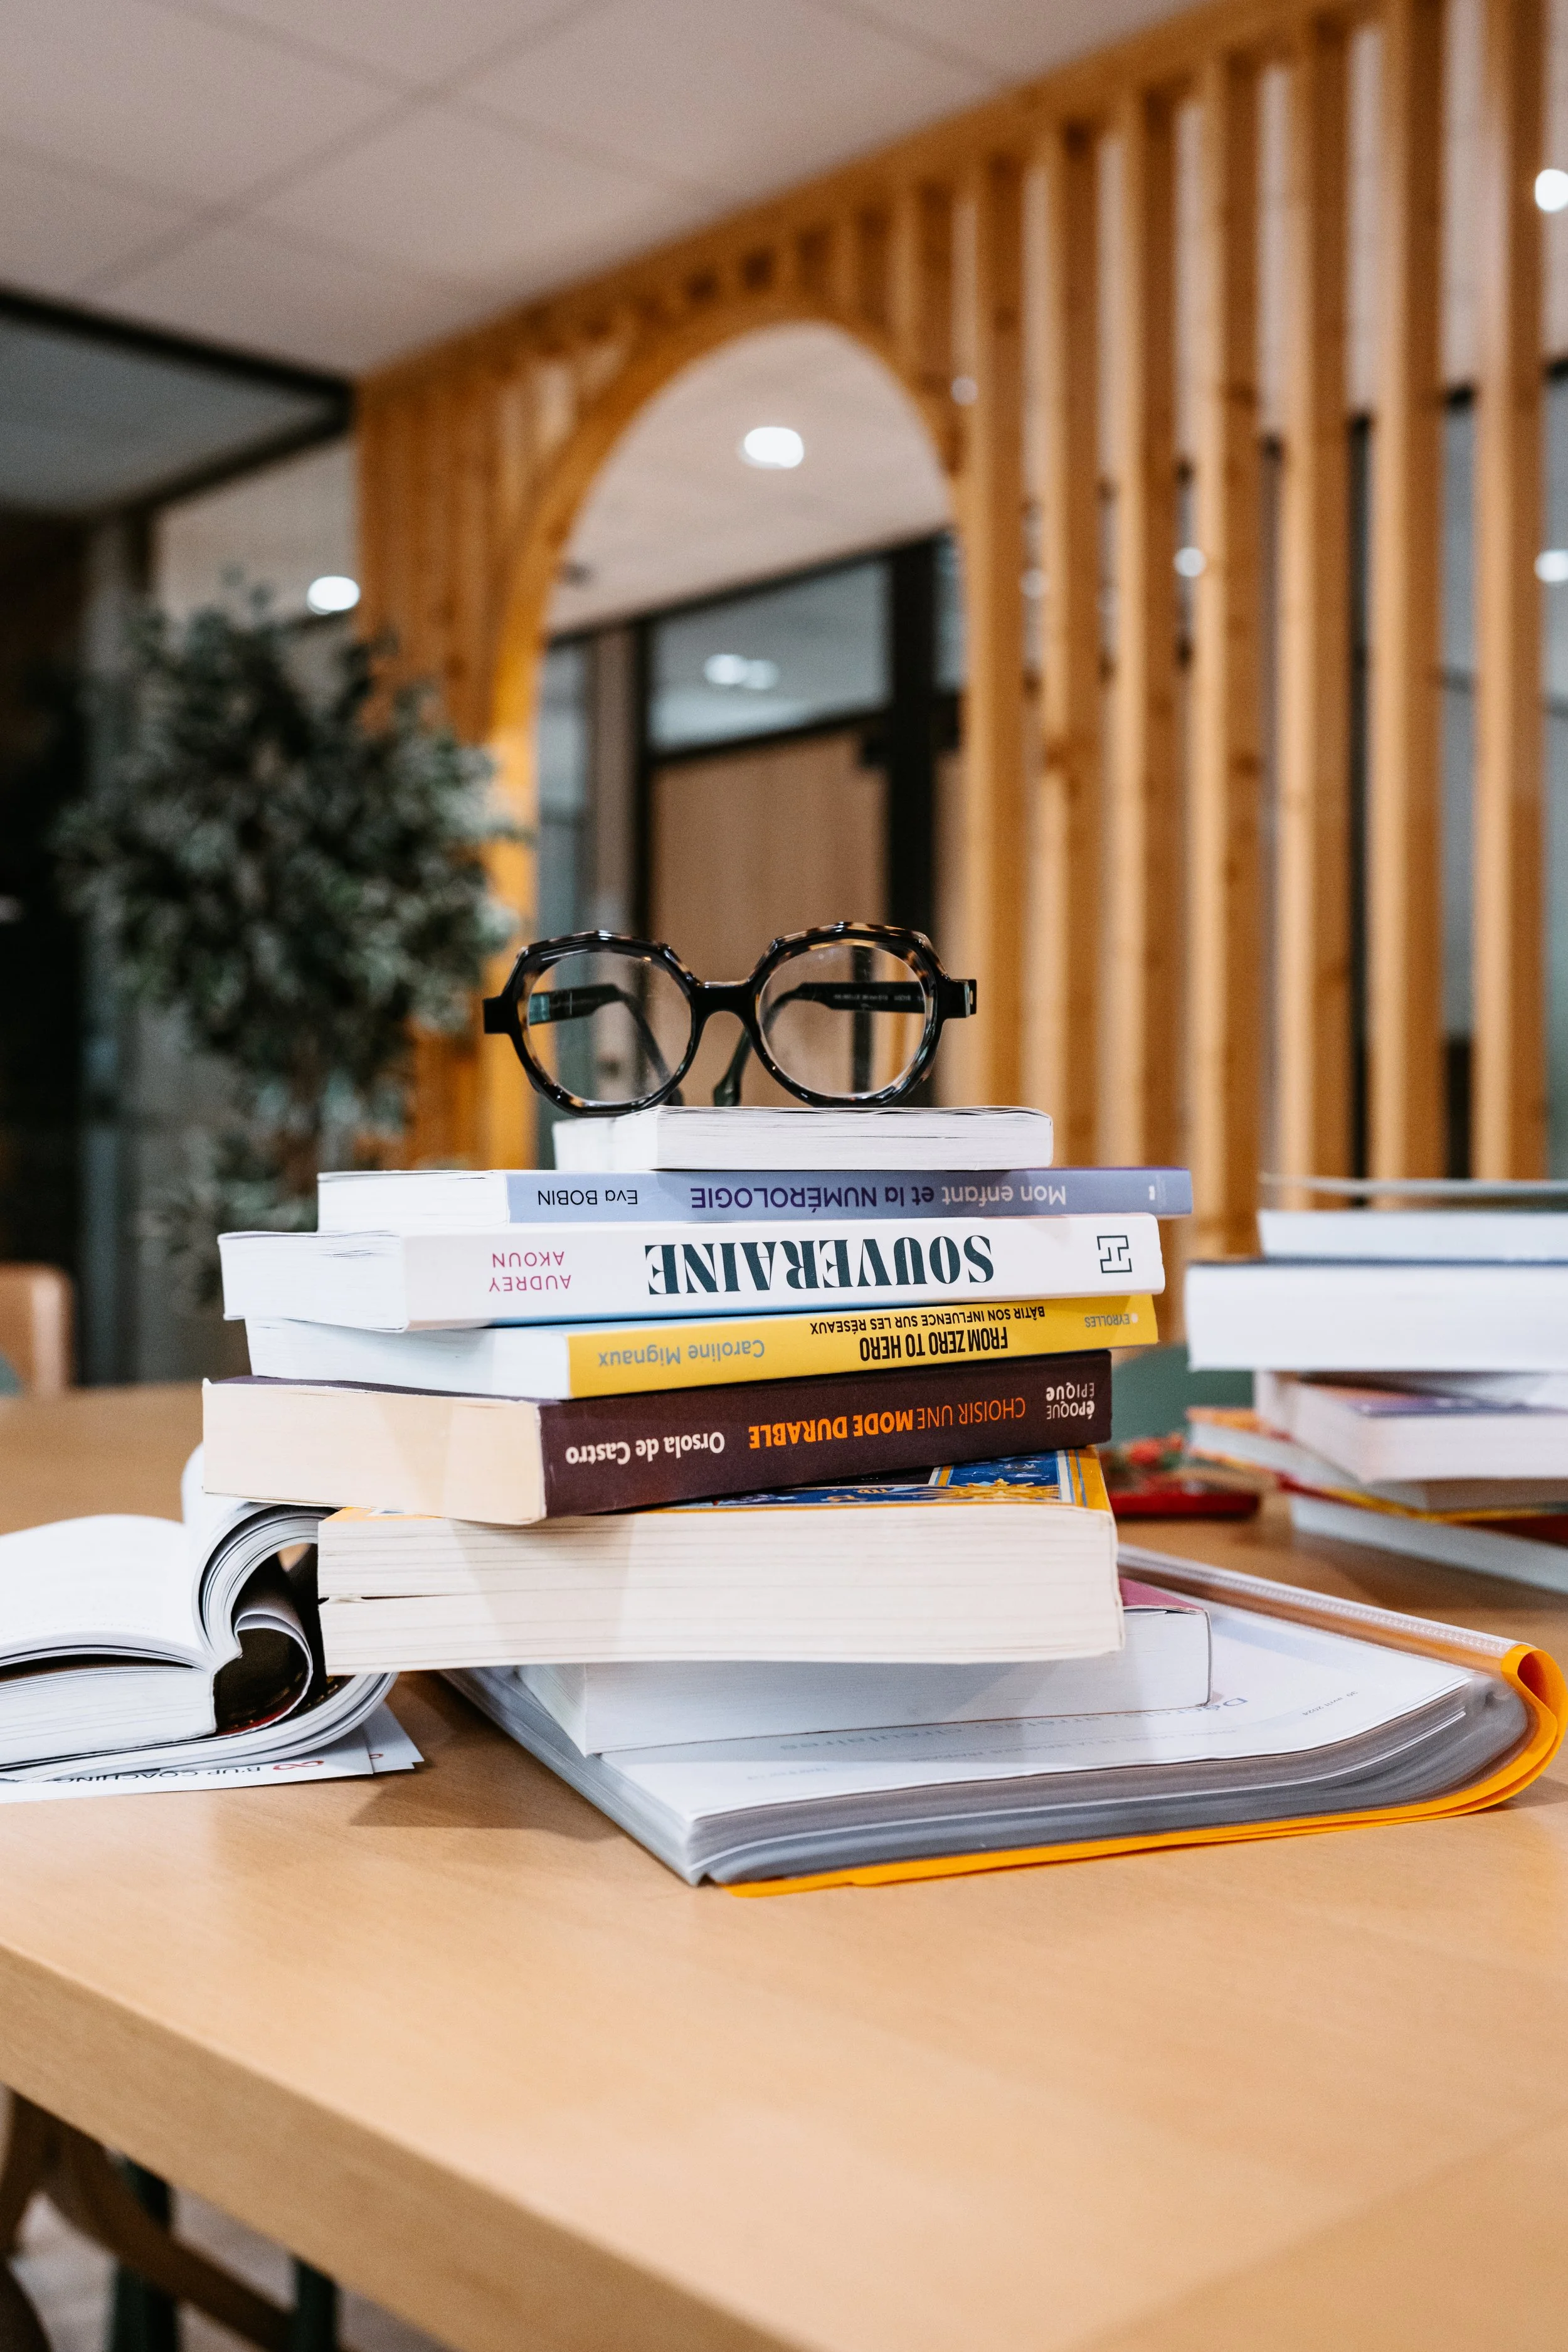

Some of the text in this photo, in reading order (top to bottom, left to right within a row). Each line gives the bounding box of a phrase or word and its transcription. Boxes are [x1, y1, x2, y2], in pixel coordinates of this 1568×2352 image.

[538, 1190, 637, 1205] Eva BOBIN
[691, 1184, 1066, 1213] Mon enfant et la NUMÉROLOGIE
[492, 1252, 564, 1267] AKOUN
[645, 1235, 993, 1295] SOUVERAINE
[489, 1275, 571, 1292] AUDREY
[810, 1306, 1045, 1334] BÂTIR SON INFLUENCE SUR LES RÉSEAUX
[1084, 1314, 1130, 1328] EYROLLES
[598, 1339, 765, 1366] Caroline Mignaux
[860, 1327, 1008, 1361] FROM ZERO TO HERO
[749, 1398, 1025, 1449] CHOISIR UNE MODE DURABLE
[566, 1432, 724, 1464] Orsola de Castro
[1302, 1706, 1324, 1716] 2024
